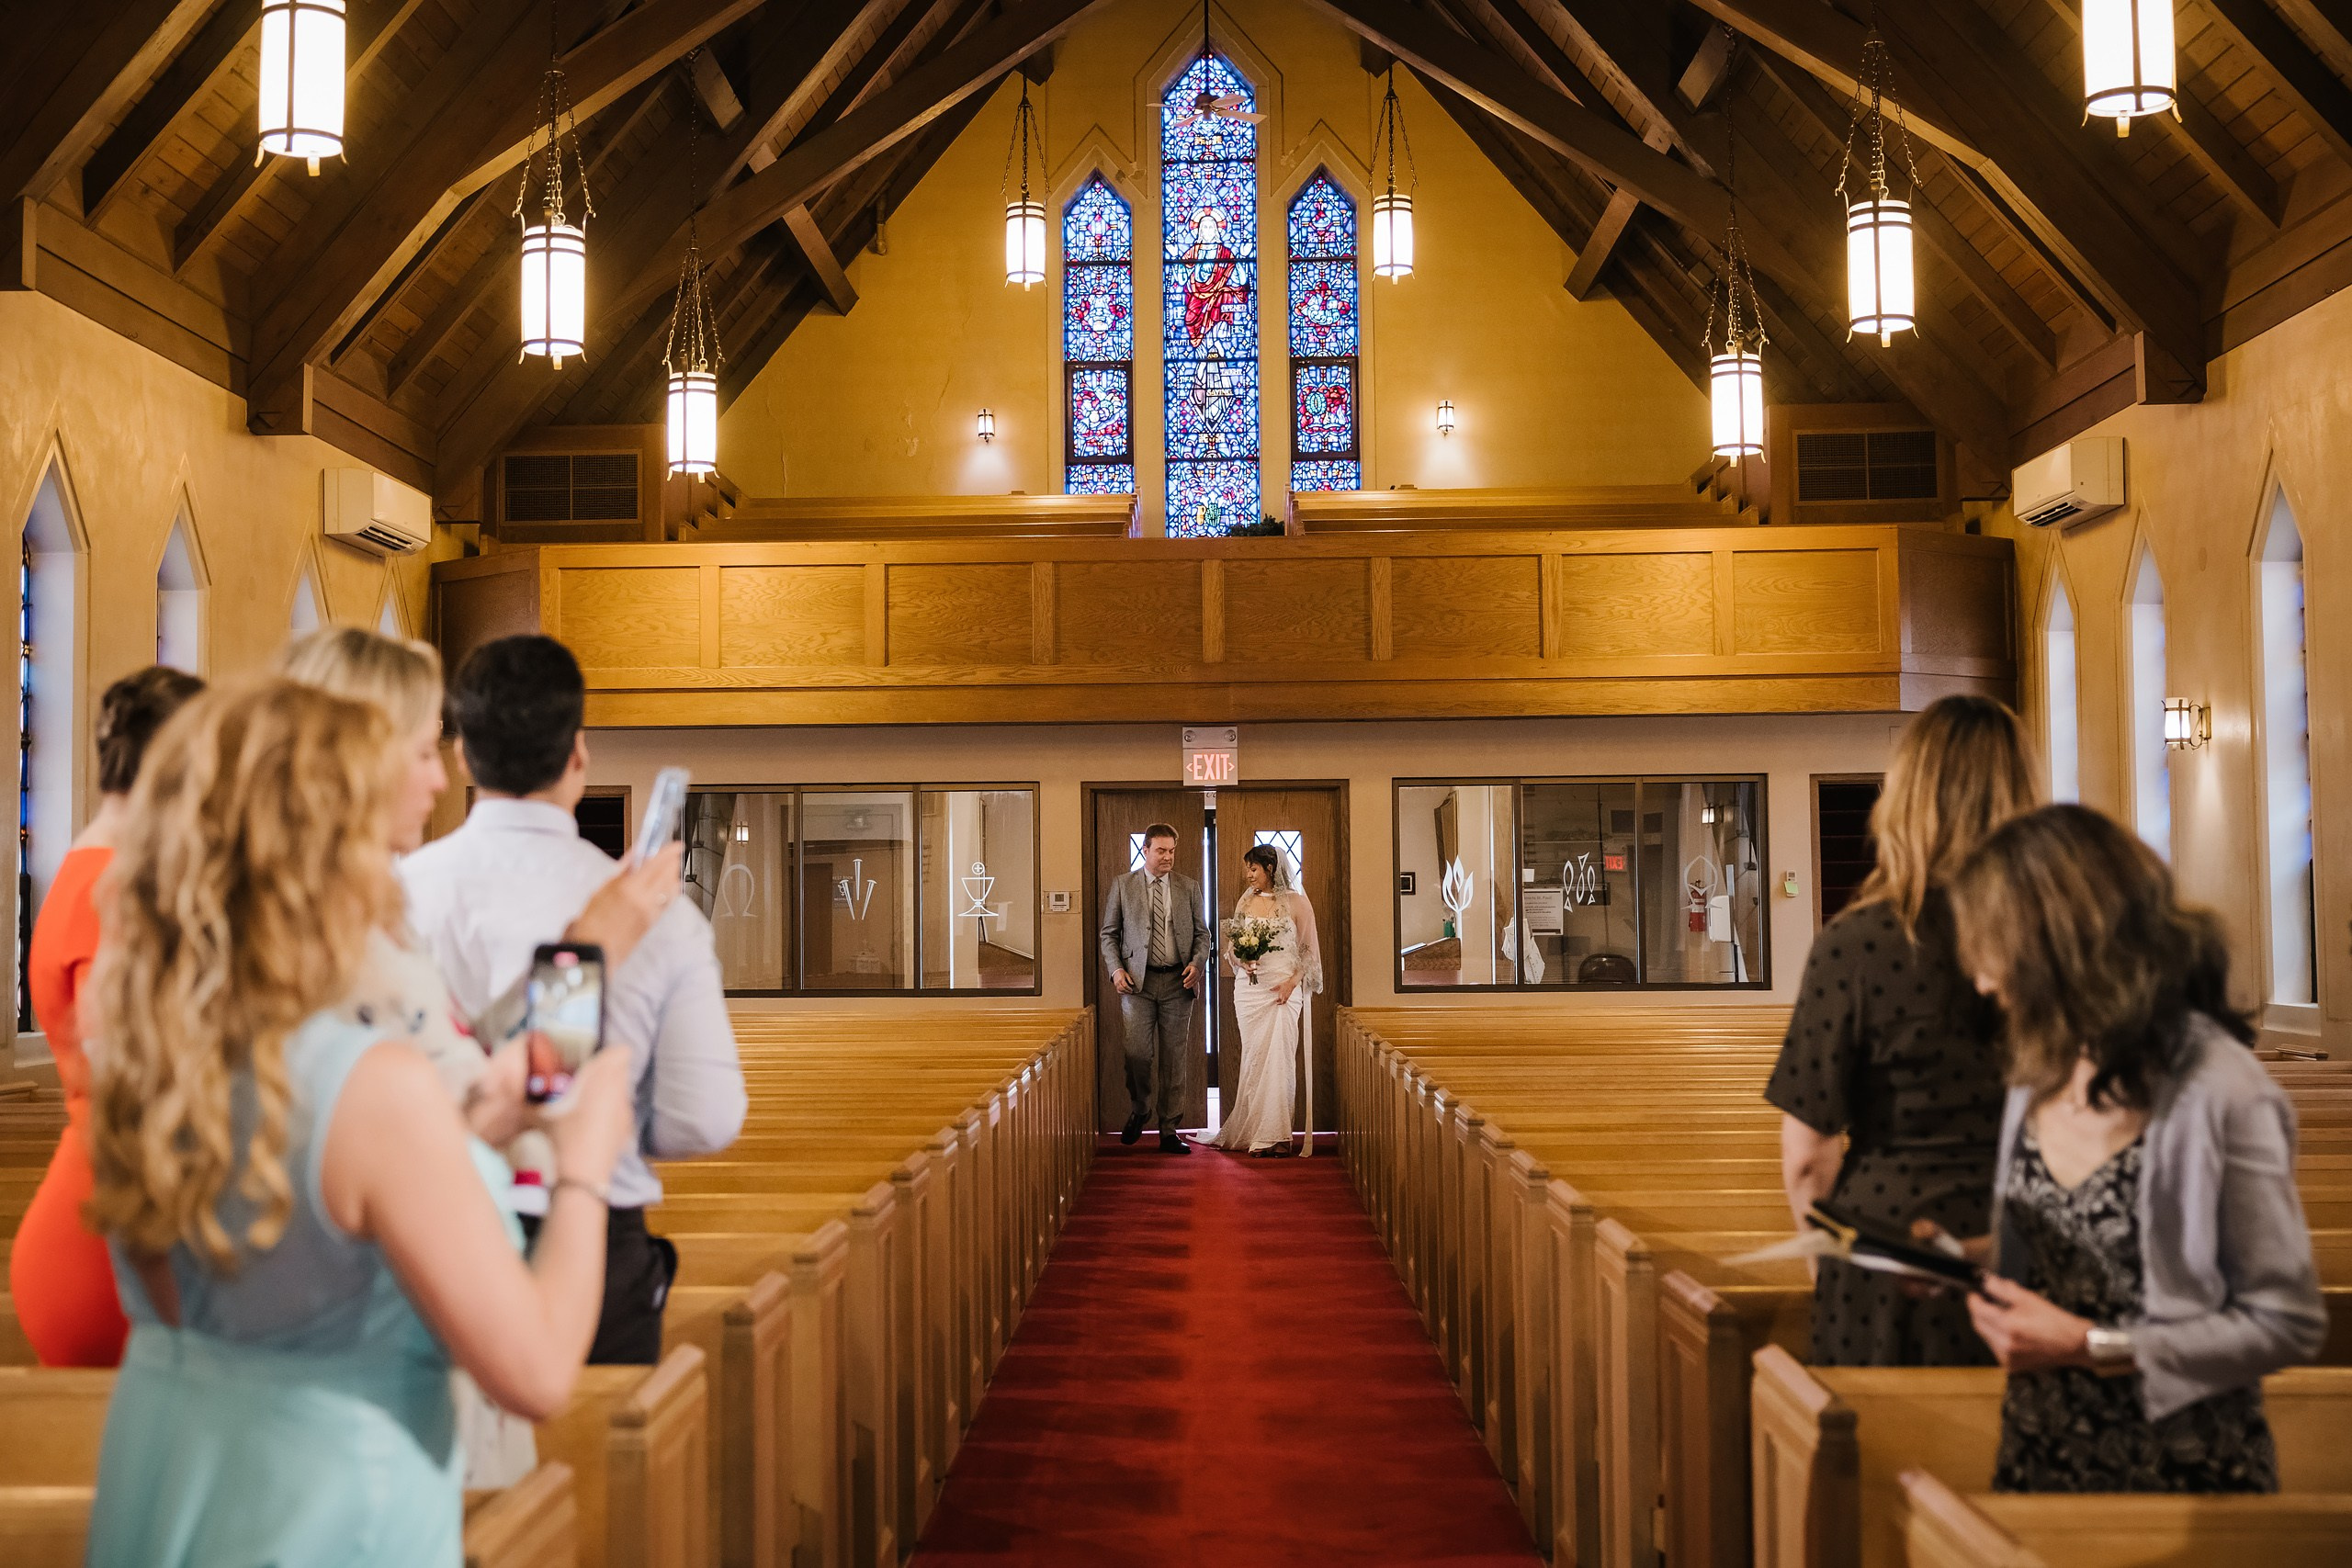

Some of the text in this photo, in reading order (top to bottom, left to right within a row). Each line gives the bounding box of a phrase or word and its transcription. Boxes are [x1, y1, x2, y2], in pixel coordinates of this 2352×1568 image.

[1173, 306, 1186, 320] HE
[1221, 304, 1247, 312] OPENED
[1193, 753, 1230, 781] EXIT
